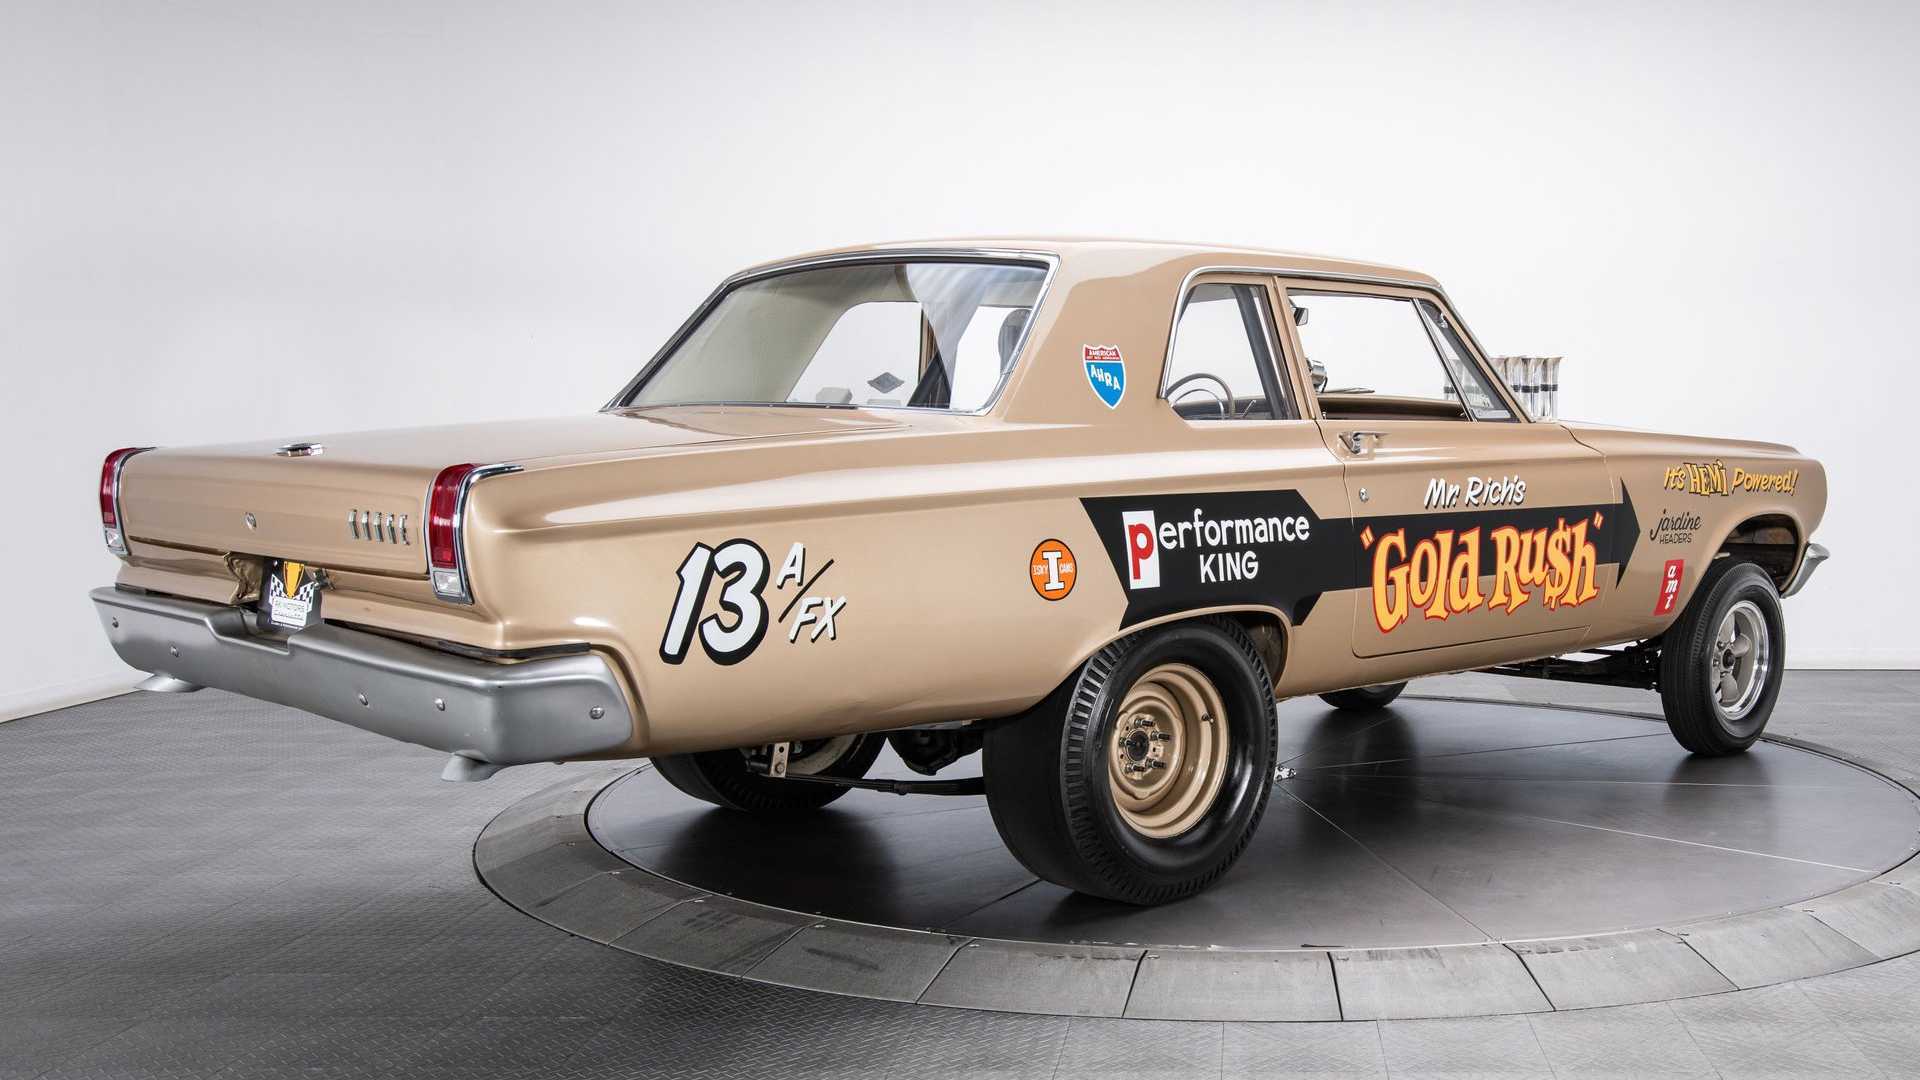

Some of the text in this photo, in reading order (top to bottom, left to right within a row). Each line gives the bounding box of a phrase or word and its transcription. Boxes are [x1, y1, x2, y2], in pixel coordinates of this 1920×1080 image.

[1090, 364, 1121, 390] AHRA
[1465, 475, 1526, 507] Rich's
[1663, 466, 1686, 490] It's
[1731, 467, 1799, 496] Powered!
[1650, 508, 1702, 540] jardine
[1659, 532, 1693, 544] HEADERS
[1128, 508, 1310, 580] performance
[1200, 550, 1259, 583] KING
[659, 538, 771, 666] 13
[1665, 564, 1678, 610] amt
